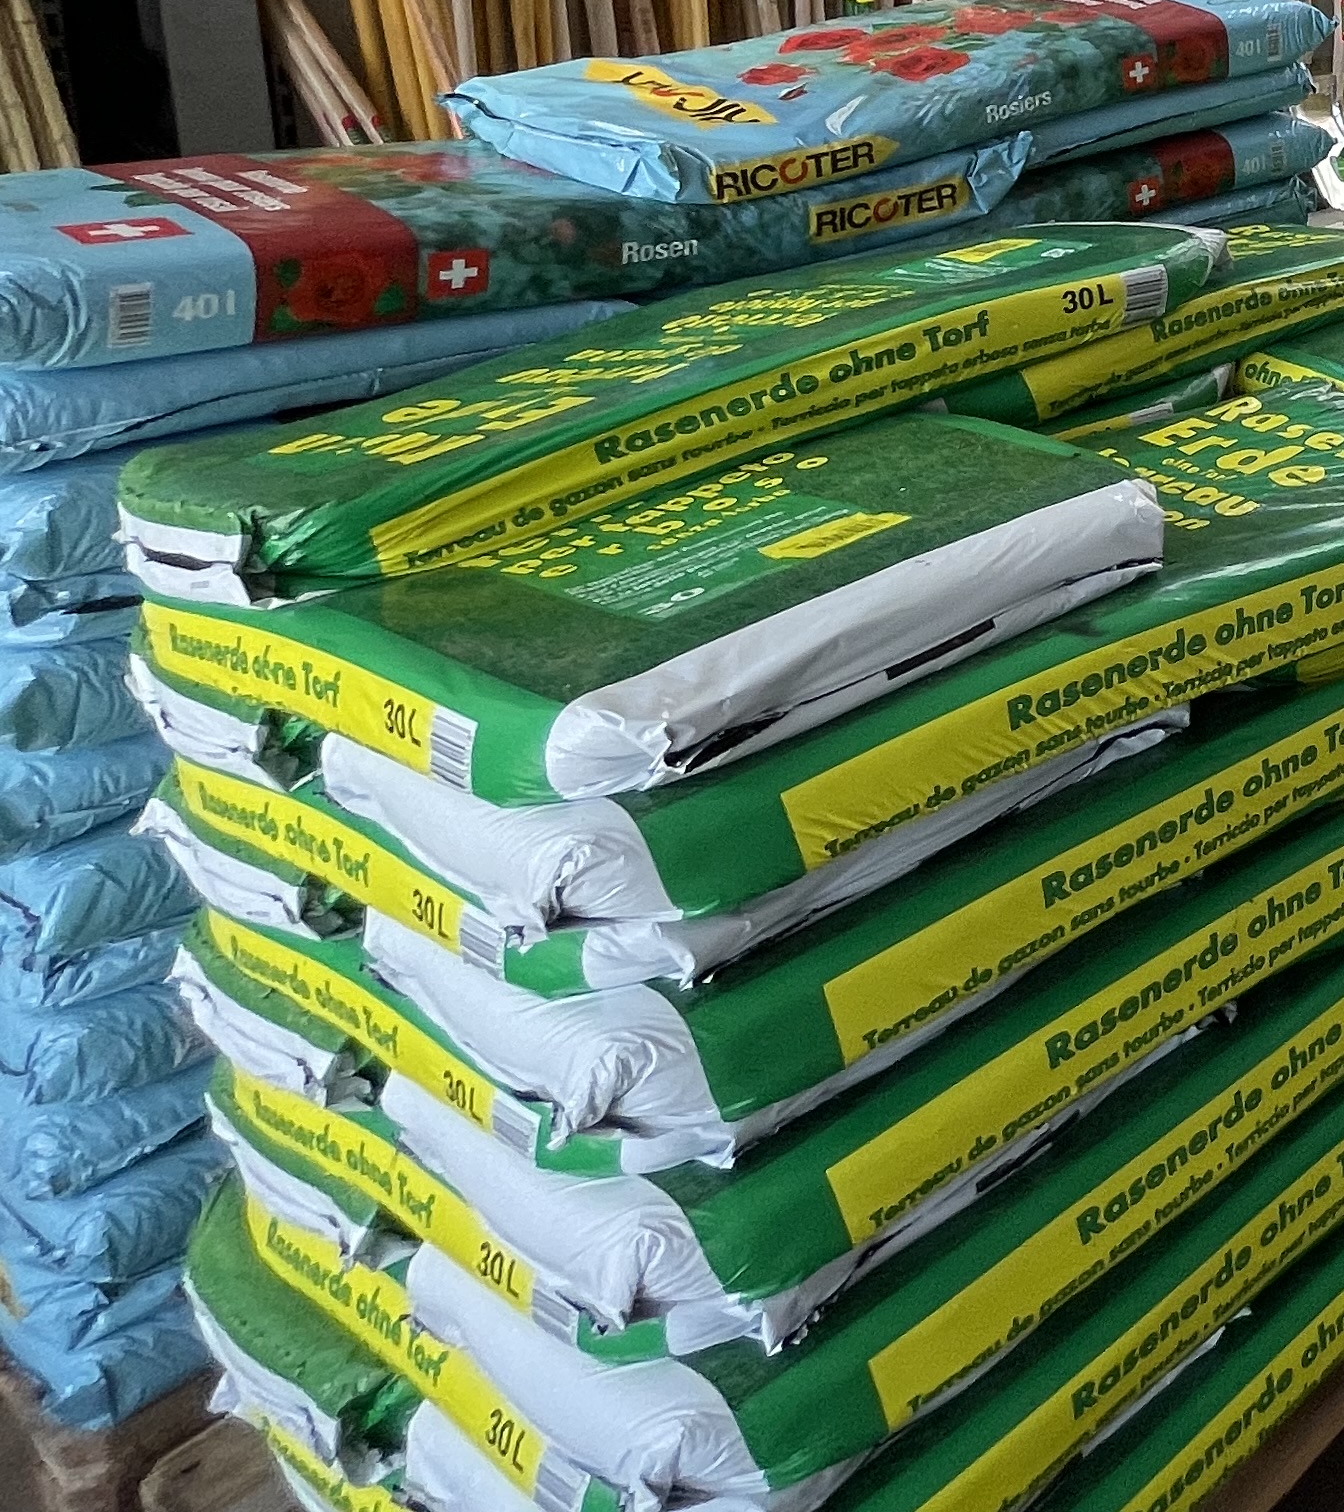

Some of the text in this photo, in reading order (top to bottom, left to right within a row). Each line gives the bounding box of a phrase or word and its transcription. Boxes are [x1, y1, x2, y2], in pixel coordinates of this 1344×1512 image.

[985, 89, 1052, 125] Rosiers
[714, 141, 876, 201] RICOTER
[815, 183, 958, 237] RICOTER
[621, 239, 699, 266] Rosen
[172, 294, 219, 322] 40
[1151, 288, 1273, 343] Rasenerde
[594, 372, 821, 465] Rasenerde
[829, 342, 916, 384] ohne
[922, 310, 990, 352] Torf
[1138, 417, 1327, 487] Erde
[252, 645, 297, 691] ohne
[302, 662, 343, 708] Torf
[1005, 627, 1208, 731] Rasenerde
[1213, 607, 1294, 647] ohne
[1035, 723, 1085, 758] sans
[1085, 694, 1150, 735] tourbe
[1040, 786, 1234, 910] Rasenerde
[1243, 742, 1320, 798] ohne
[332, 837, 370, 887] Torf
[862, 987, 957, 1050] Terreau
[962, 961, 993, 990] de
[998, 922, 1067, 974] gazon
[1070, 895, 1116, 931] sans
[1118, 858, 1180, 901] tourbe
[1192, 809, 1260, 861] Terriccio
[1262, 794, 1289, 823] per
[1045, 932, 1239, 1071] Rasenerde
[1245, 881, 1322, 940] ohne
[362, 1006, 399, 1057] Torf
[868, 1157, 962, 1229] Terreau
[967, 1134, 998, 1163] de
[1001, 1085, 1072, 1141] gazon
[1075, 1052, 1120, 1090] sans
[1123, 1009, 1184, 1057] tourbe
[1198, 955, 1265, 1008] Terriccio
[1268, 935, 1297, 969] per
[1076, 1087, 1263, 1247] Rasenerde
[1270, 1026, 1343, 1090] ohne
[396, 1172, 436, 1228] Torf
[1070, 1245, 1252, 1420] Rasenerde
[1260, 1175, 1332, 1248] ohne
